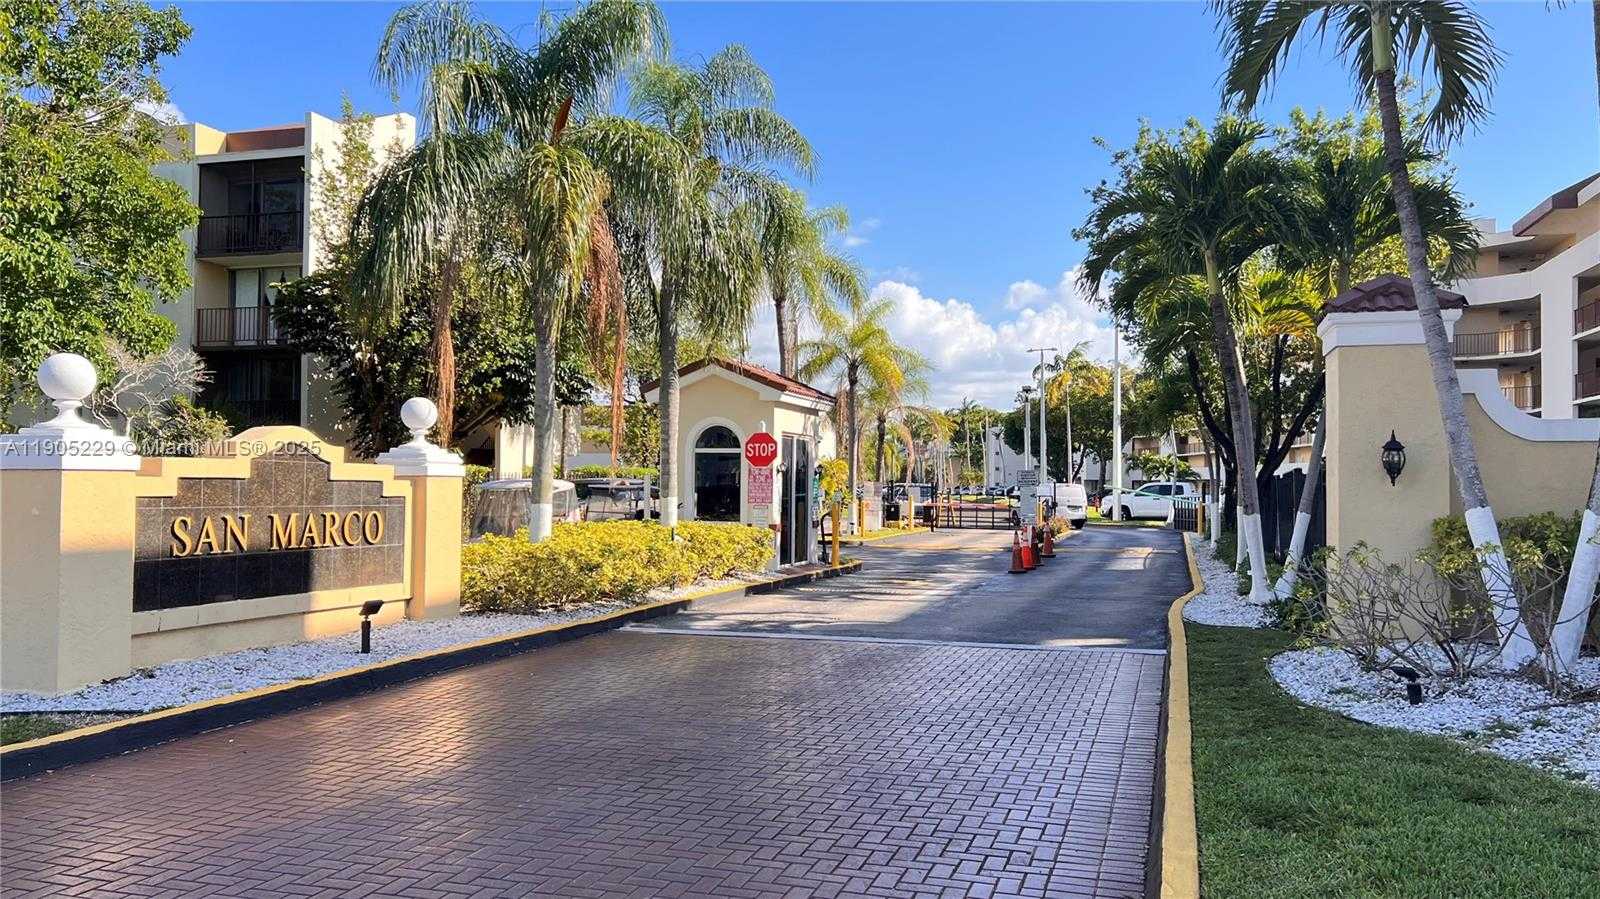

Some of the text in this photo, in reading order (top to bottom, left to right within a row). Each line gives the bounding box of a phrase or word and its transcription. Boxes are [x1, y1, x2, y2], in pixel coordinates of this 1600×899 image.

[746, 443, 776, 457] STOP
[170, 510, 385, 558] SAN MARCO
